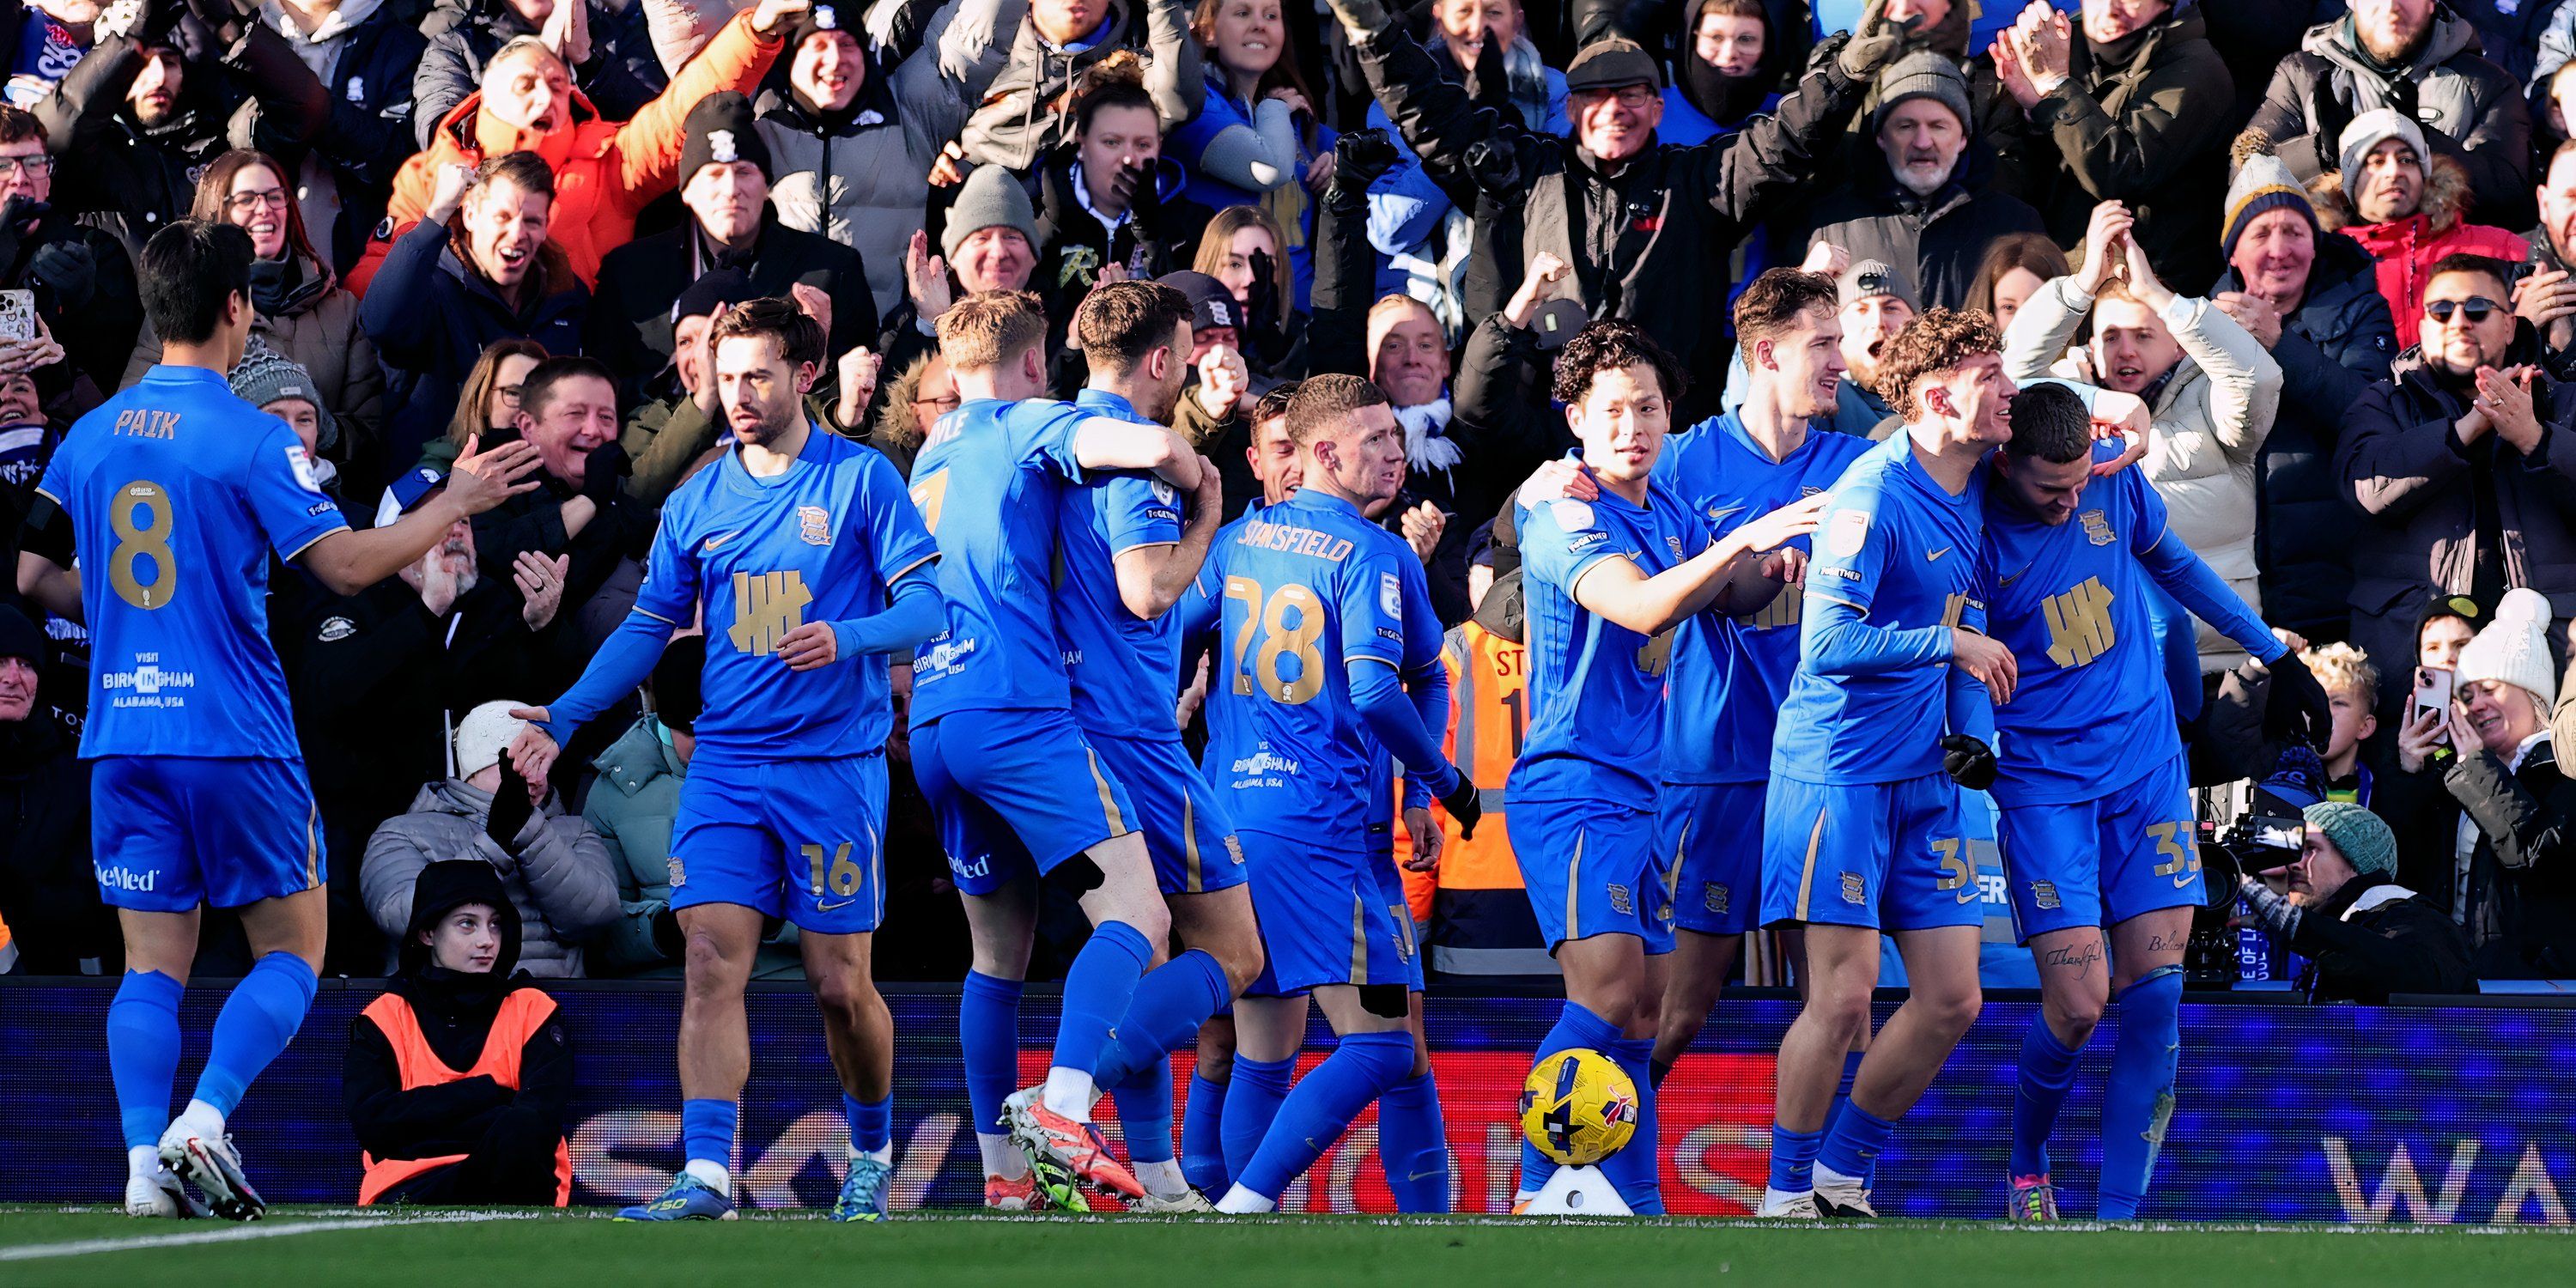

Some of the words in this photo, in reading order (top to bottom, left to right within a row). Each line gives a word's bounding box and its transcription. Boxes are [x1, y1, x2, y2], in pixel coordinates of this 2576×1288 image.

[113, 409, 181, 440] PAIK
[109, 480, 177, 610] 8
[1237, 519, 1354, 562] STANSFIELD
[102, 666, 195, 691] BIRMINGHAM
[135, 652, 159, 663] VISIT
[801, 841, 862, 896] 16
[2146, 822, 2202, 877] 33
